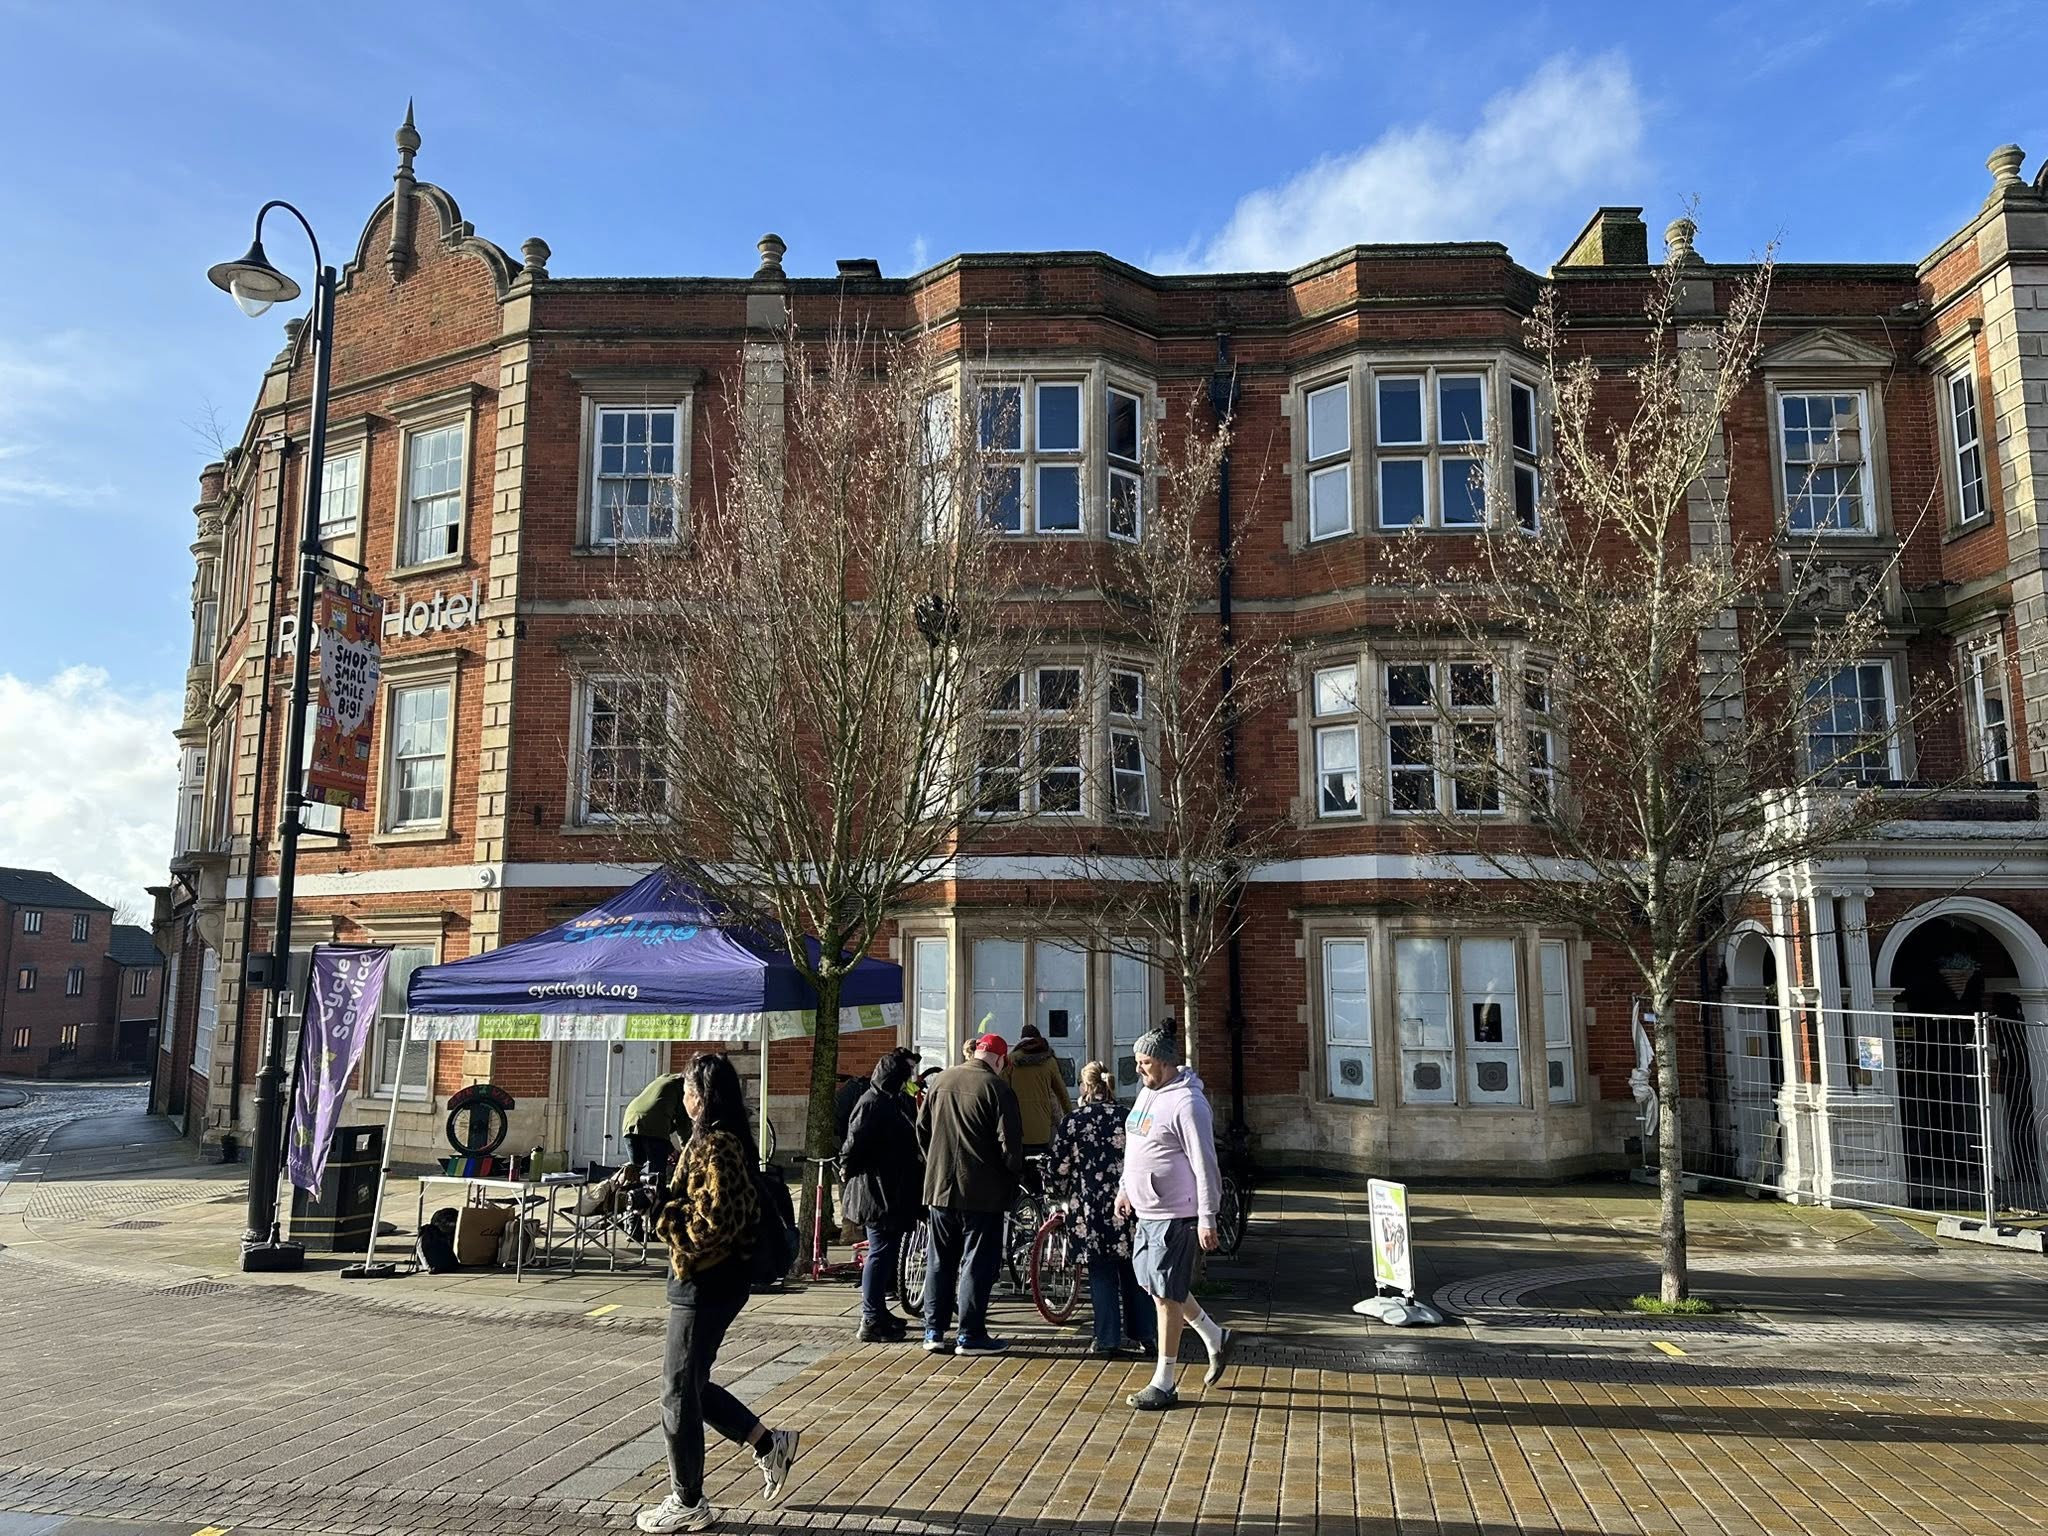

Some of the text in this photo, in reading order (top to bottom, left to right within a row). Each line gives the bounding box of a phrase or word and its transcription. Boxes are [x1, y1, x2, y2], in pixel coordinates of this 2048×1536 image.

[381, 579, 480, 640] Hotel
[335, 644, 367, 670] SHOP
[335, 663, 366, 684] SMALL
[564, 919, 698, 944] cycling
[575, 915, 633, 928] we are
[323, 959, 350, 1021] Cycle
[332, 954, 372, 1040] Service
[528, 981, 638, 999] cyclinguk.org
